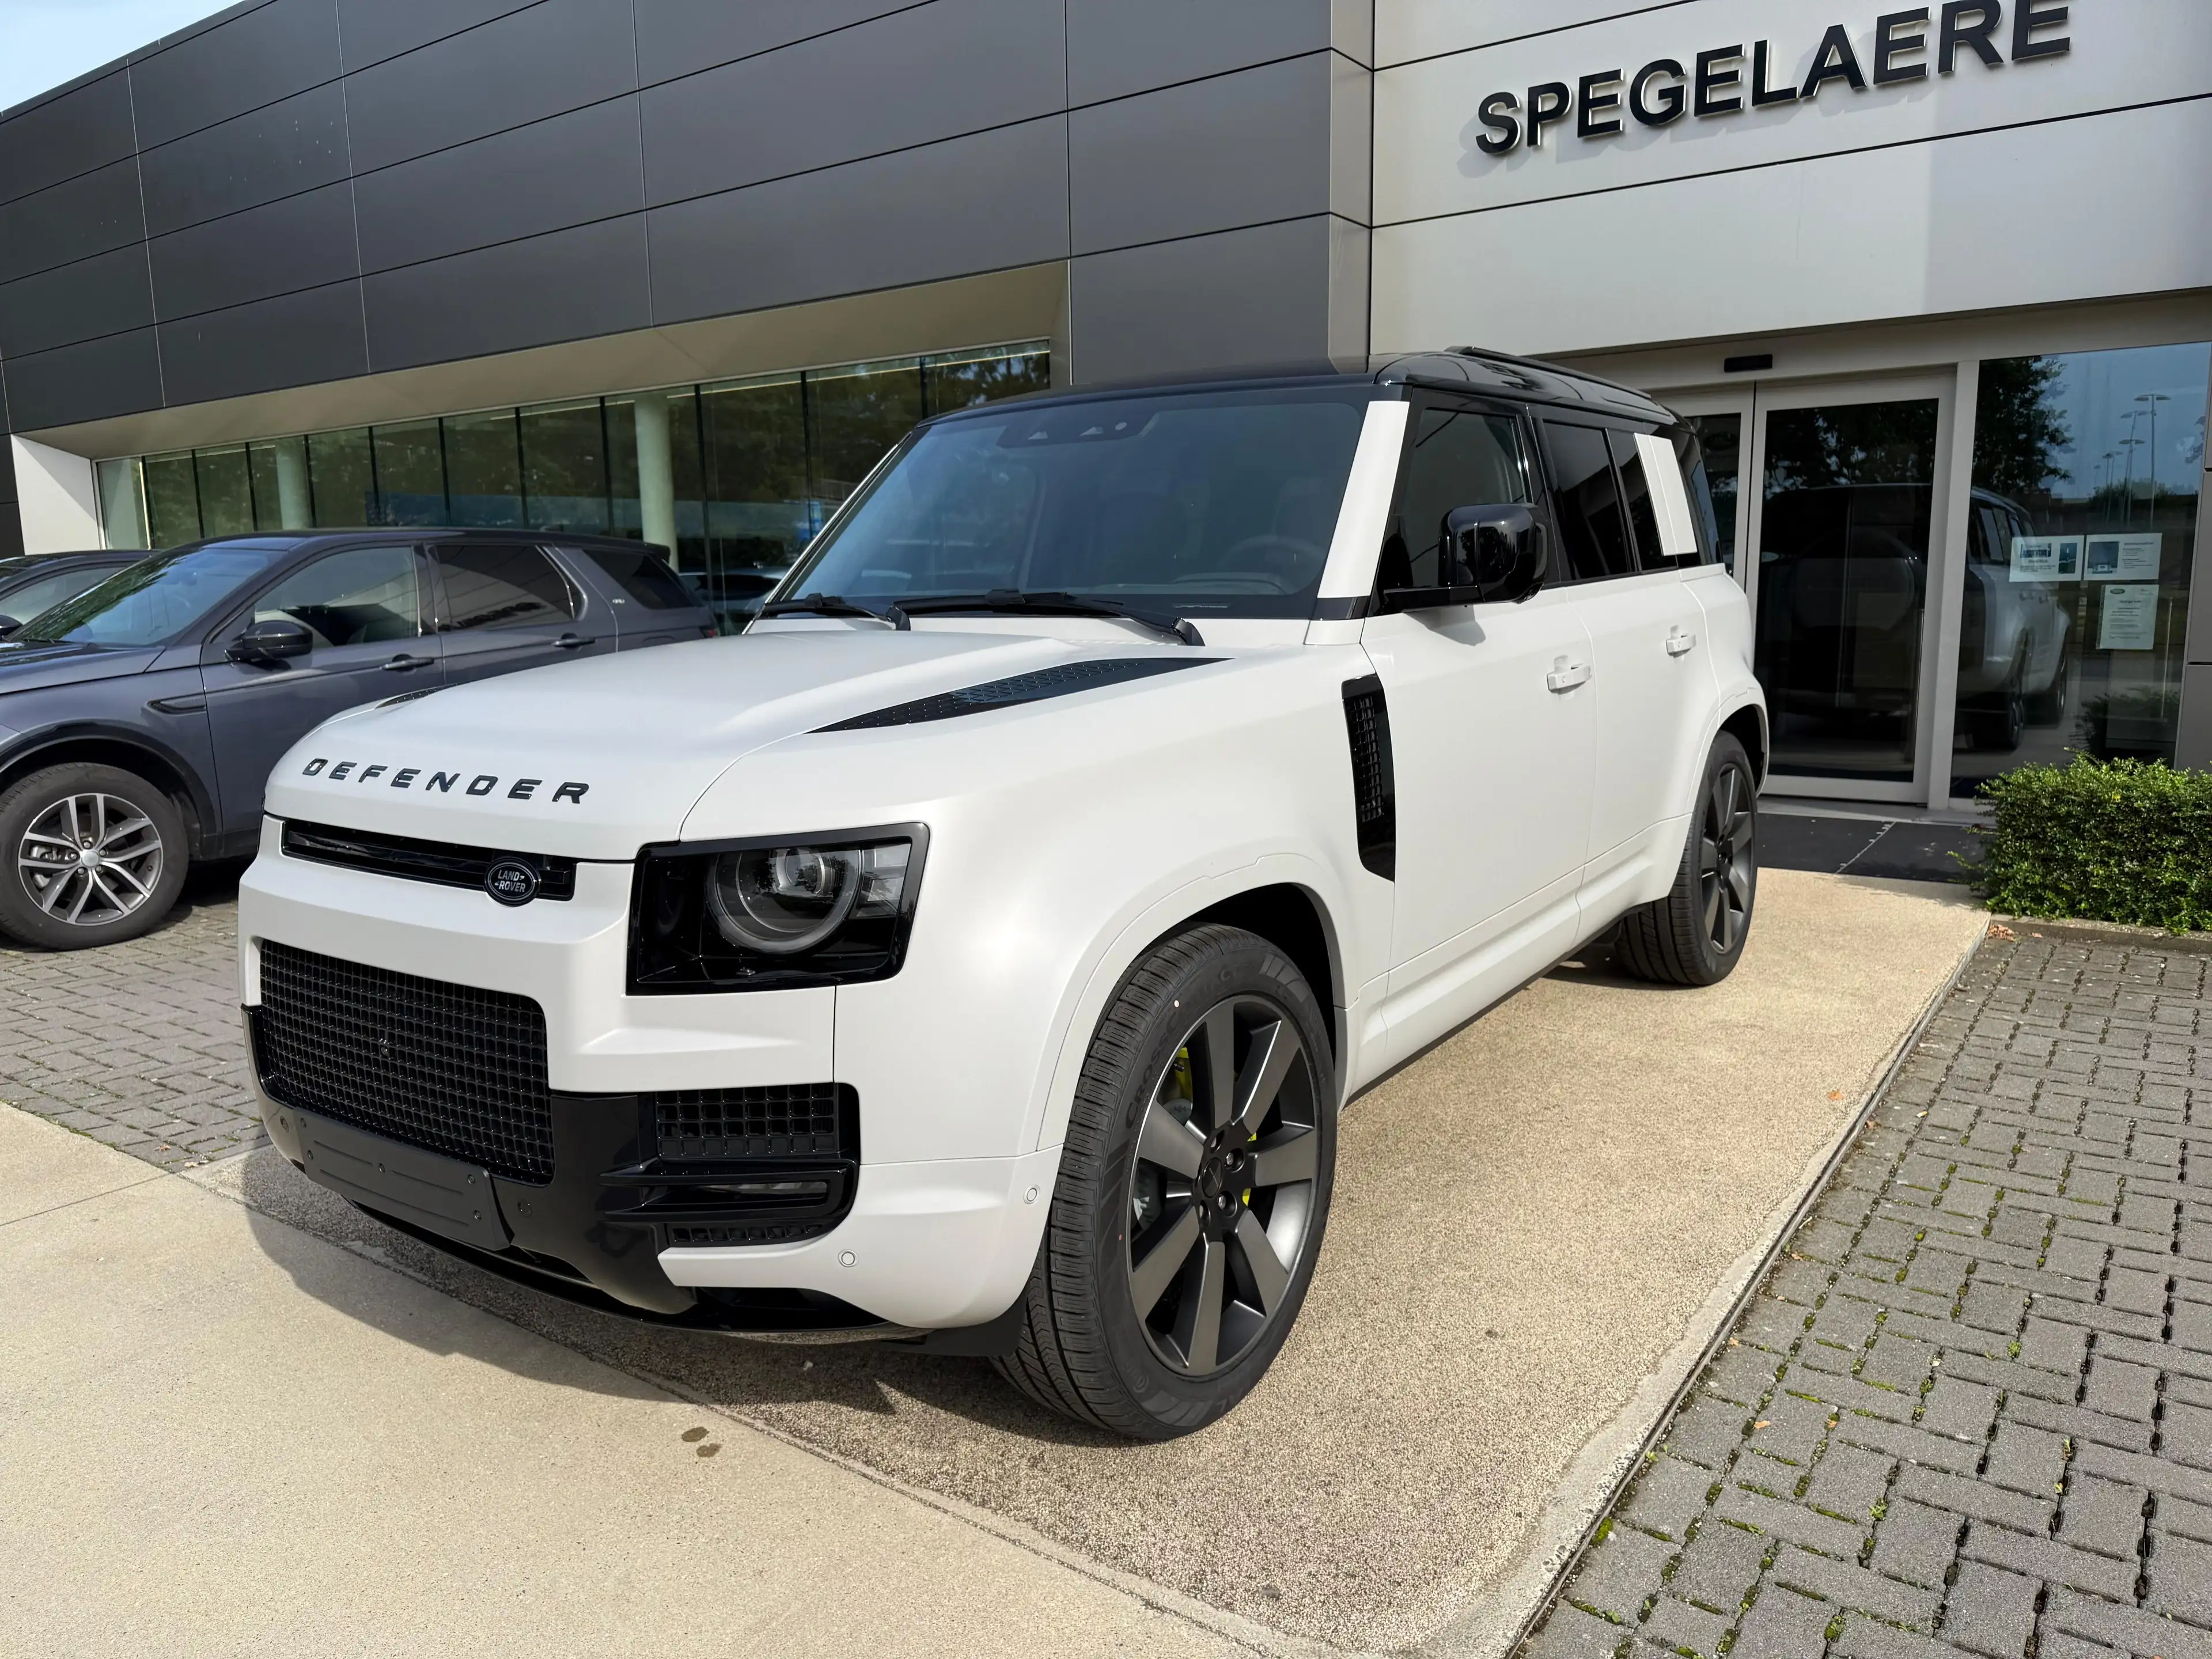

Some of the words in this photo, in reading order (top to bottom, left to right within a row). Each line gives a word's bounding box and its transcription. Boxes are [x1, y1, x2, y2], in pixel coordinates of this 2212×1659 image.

[1475, 0, 2071, 154] SPEGELAERE
[302, 757, 590, 804] DEFENDER
[498, 869, 520, 881] LAND
[499, 881, 526, 893] ROVER
